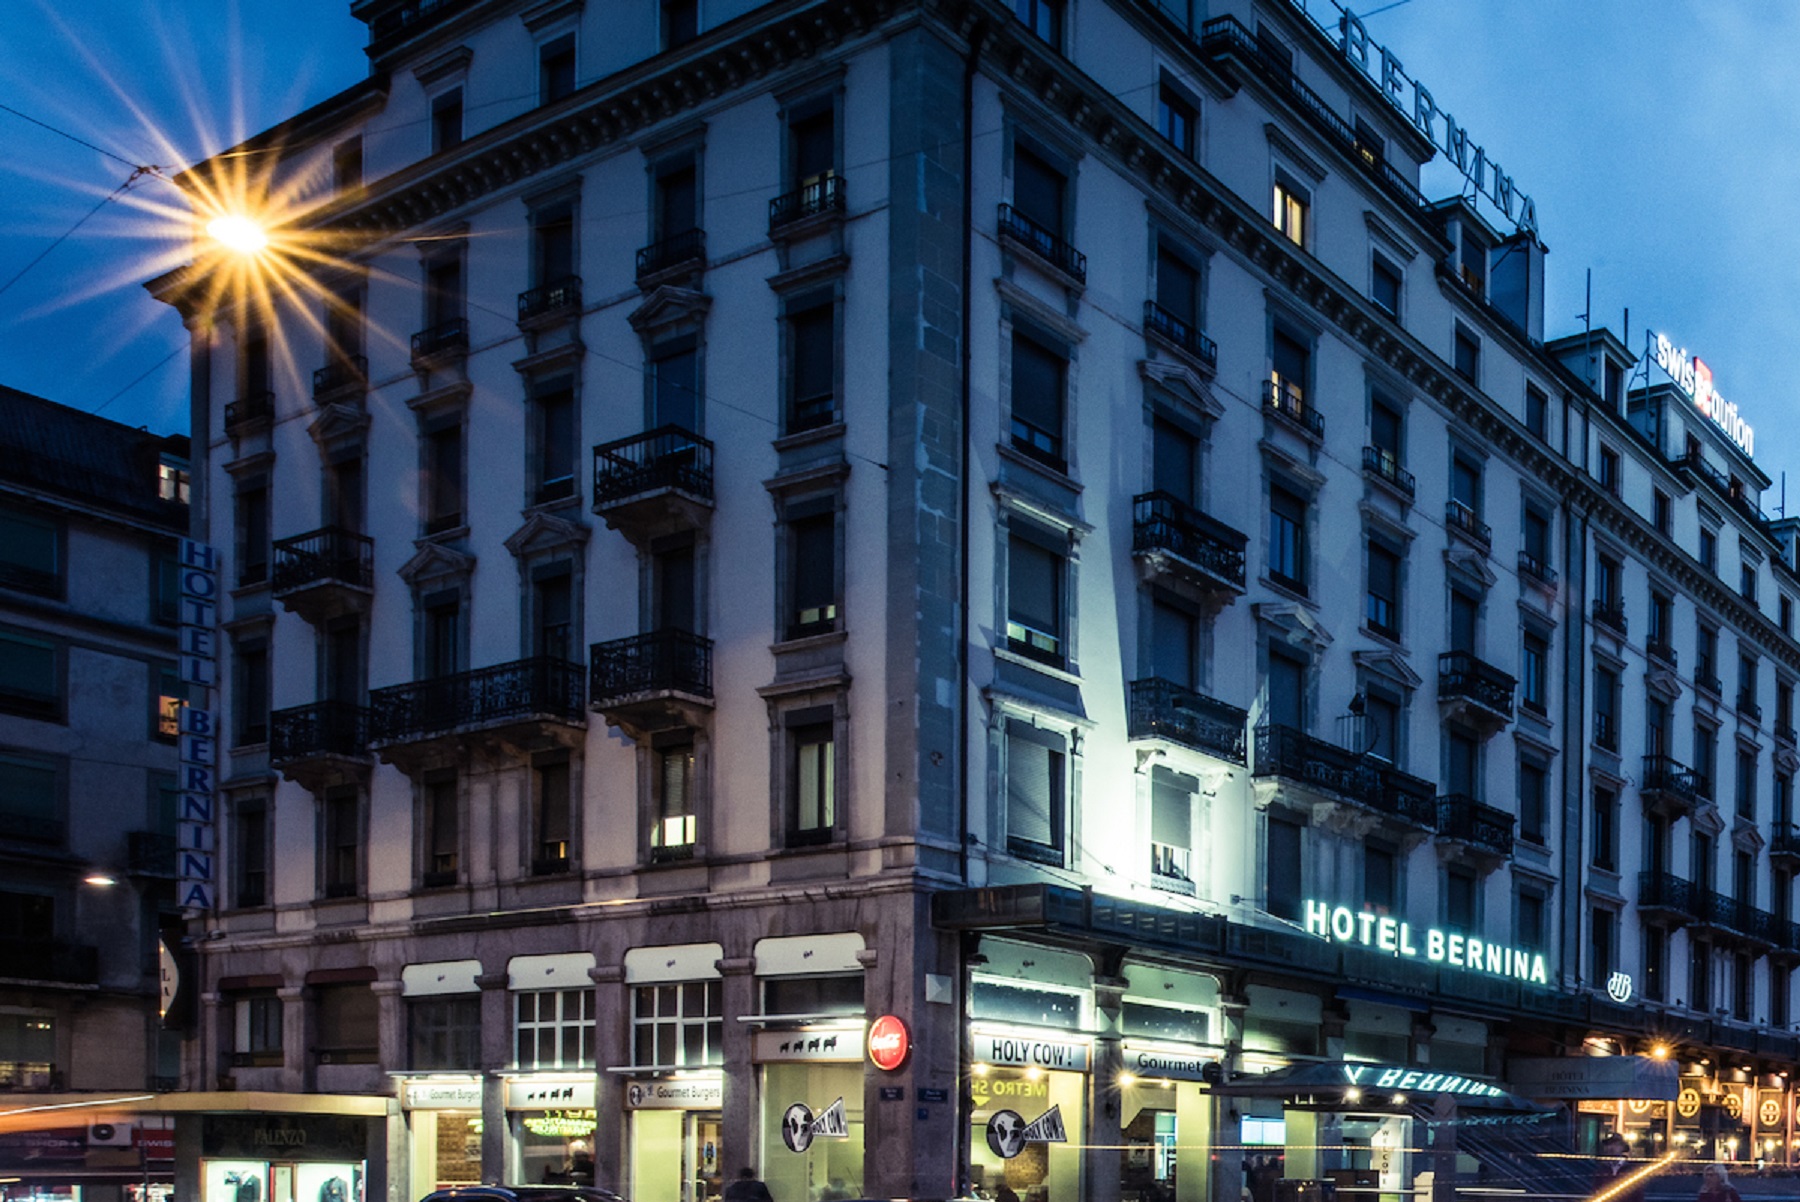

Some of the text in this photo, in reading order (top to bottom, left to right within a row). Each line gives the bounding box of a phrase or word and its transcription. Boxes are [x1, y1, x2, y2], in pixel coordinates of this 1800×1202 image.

[1340, 7, 1542, 249] BERNINA
[184, 542, 215, 908] HOTEL BERNINA
[1305, 899, 1547, 984] HOTEL BERNINA
[992, 1039, 1030, 1062] HOLY
[1138, 1053, 1201, 1074] Gourmet
[657, 1086, 690, 1098] Gourmet
